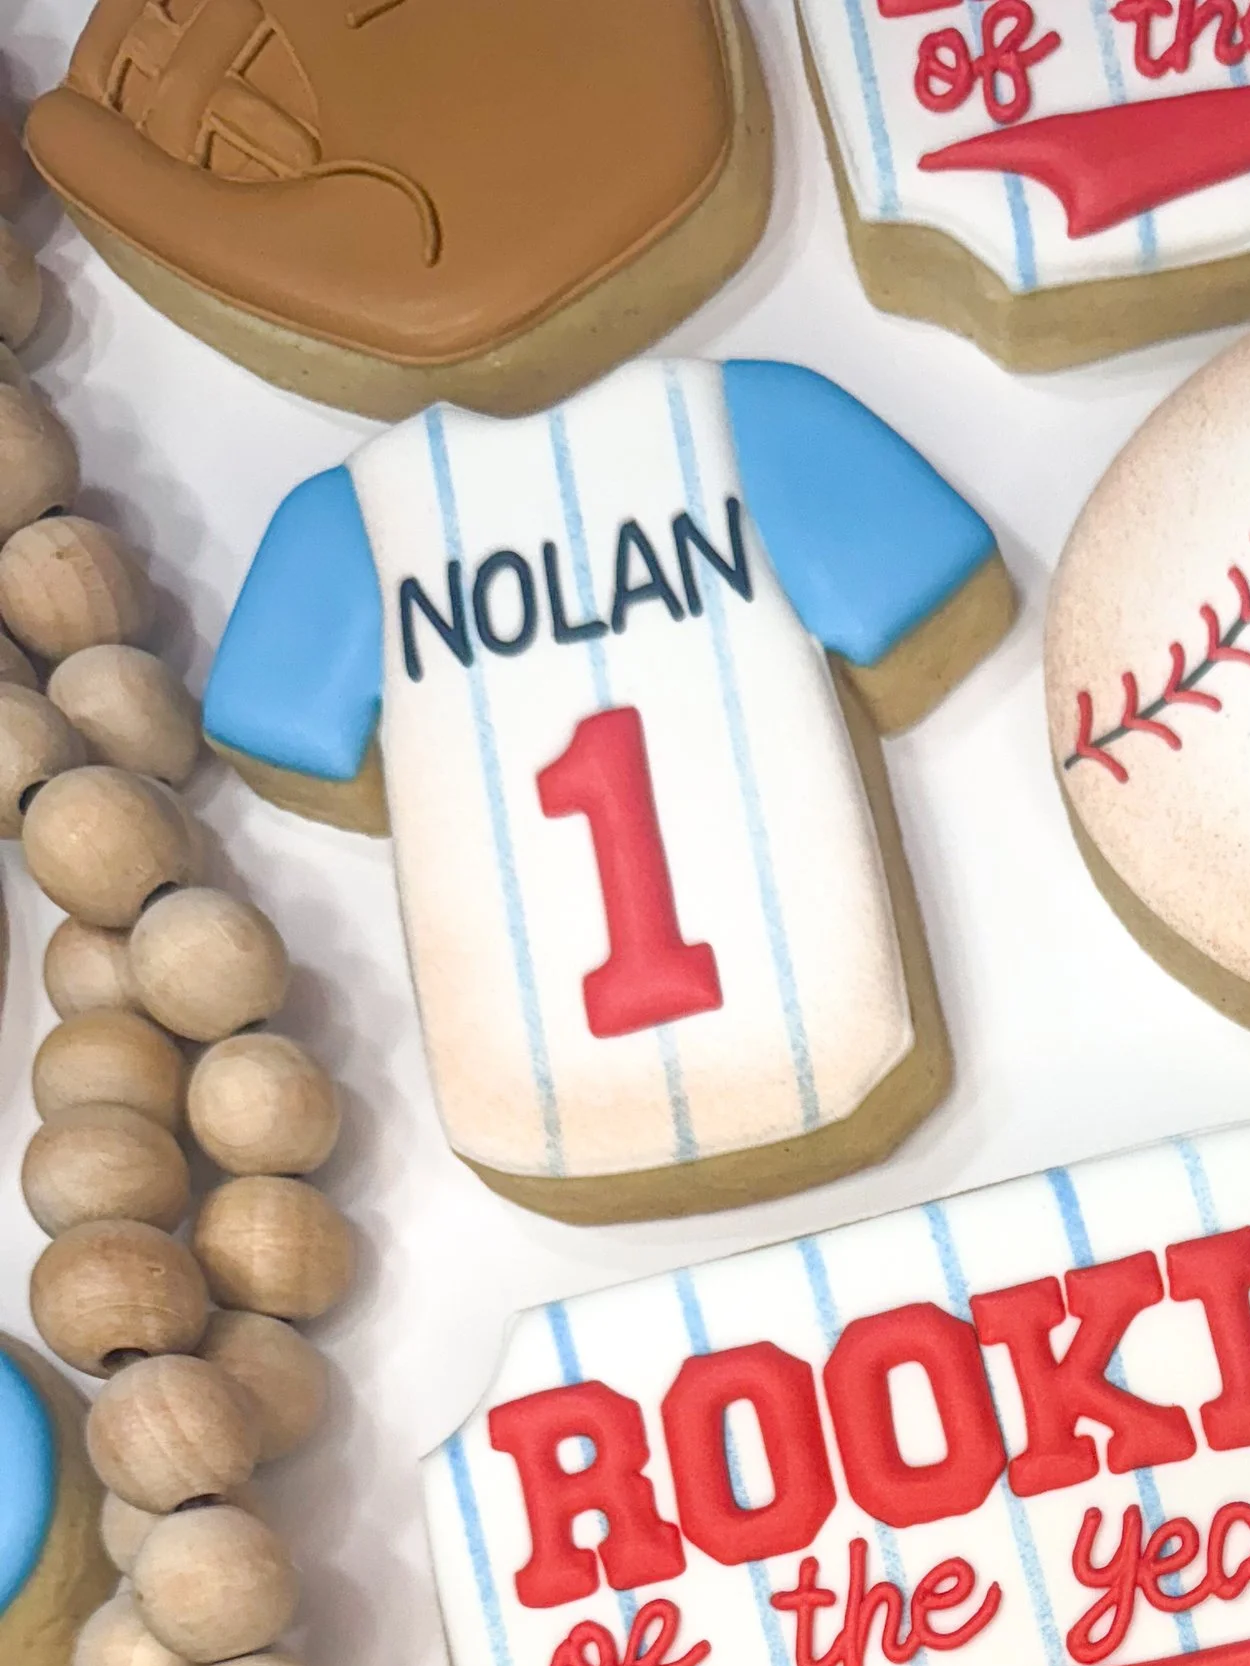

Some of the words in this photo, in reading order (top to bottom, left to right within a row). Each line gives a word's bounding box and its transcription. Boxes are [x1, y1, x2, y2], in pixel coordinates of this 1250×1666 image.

[914, 0, 1061, 125] of
[400, 497, 755, 683] NOLAN
[535, 705, 724, 1039] 1
